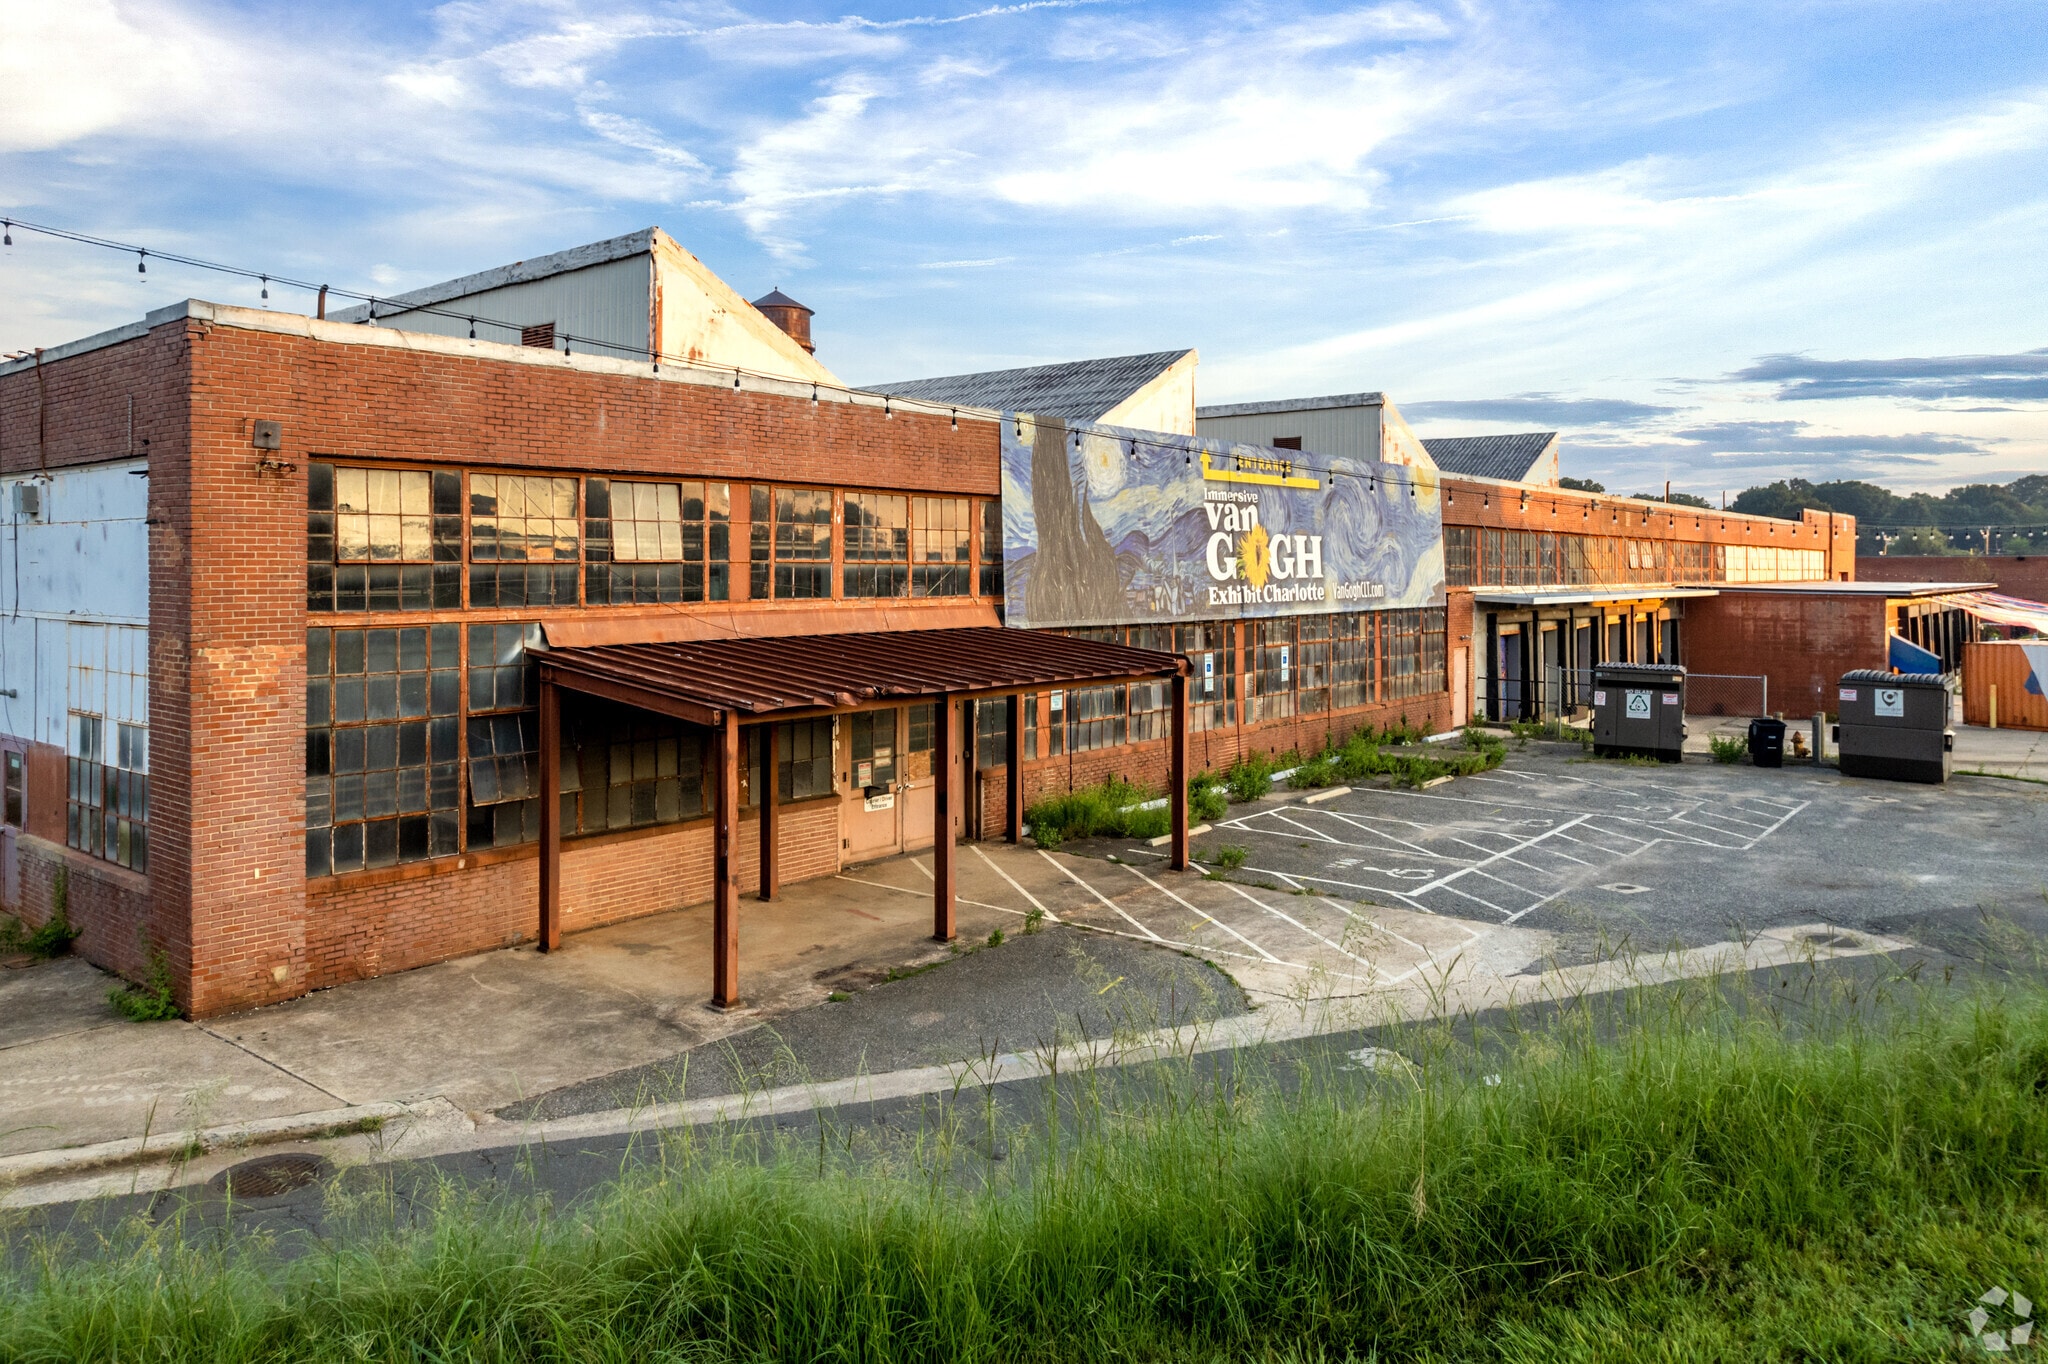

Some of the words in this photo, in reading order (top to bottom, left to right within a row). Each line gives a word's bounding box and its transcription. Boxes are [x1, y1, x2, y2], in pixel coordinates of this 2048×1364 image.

[1239, 455, 1292, 473] ENTRANCE
[1203, 487, 1259, 504] Immersive
[1203, 502, 1259, 532] van
[1208, 585, 1263, 605] Exhibit
[1263, 582, 1325, 603] Charlotte
[1332, 581, 1384, 601] VanGoghCLT.com
